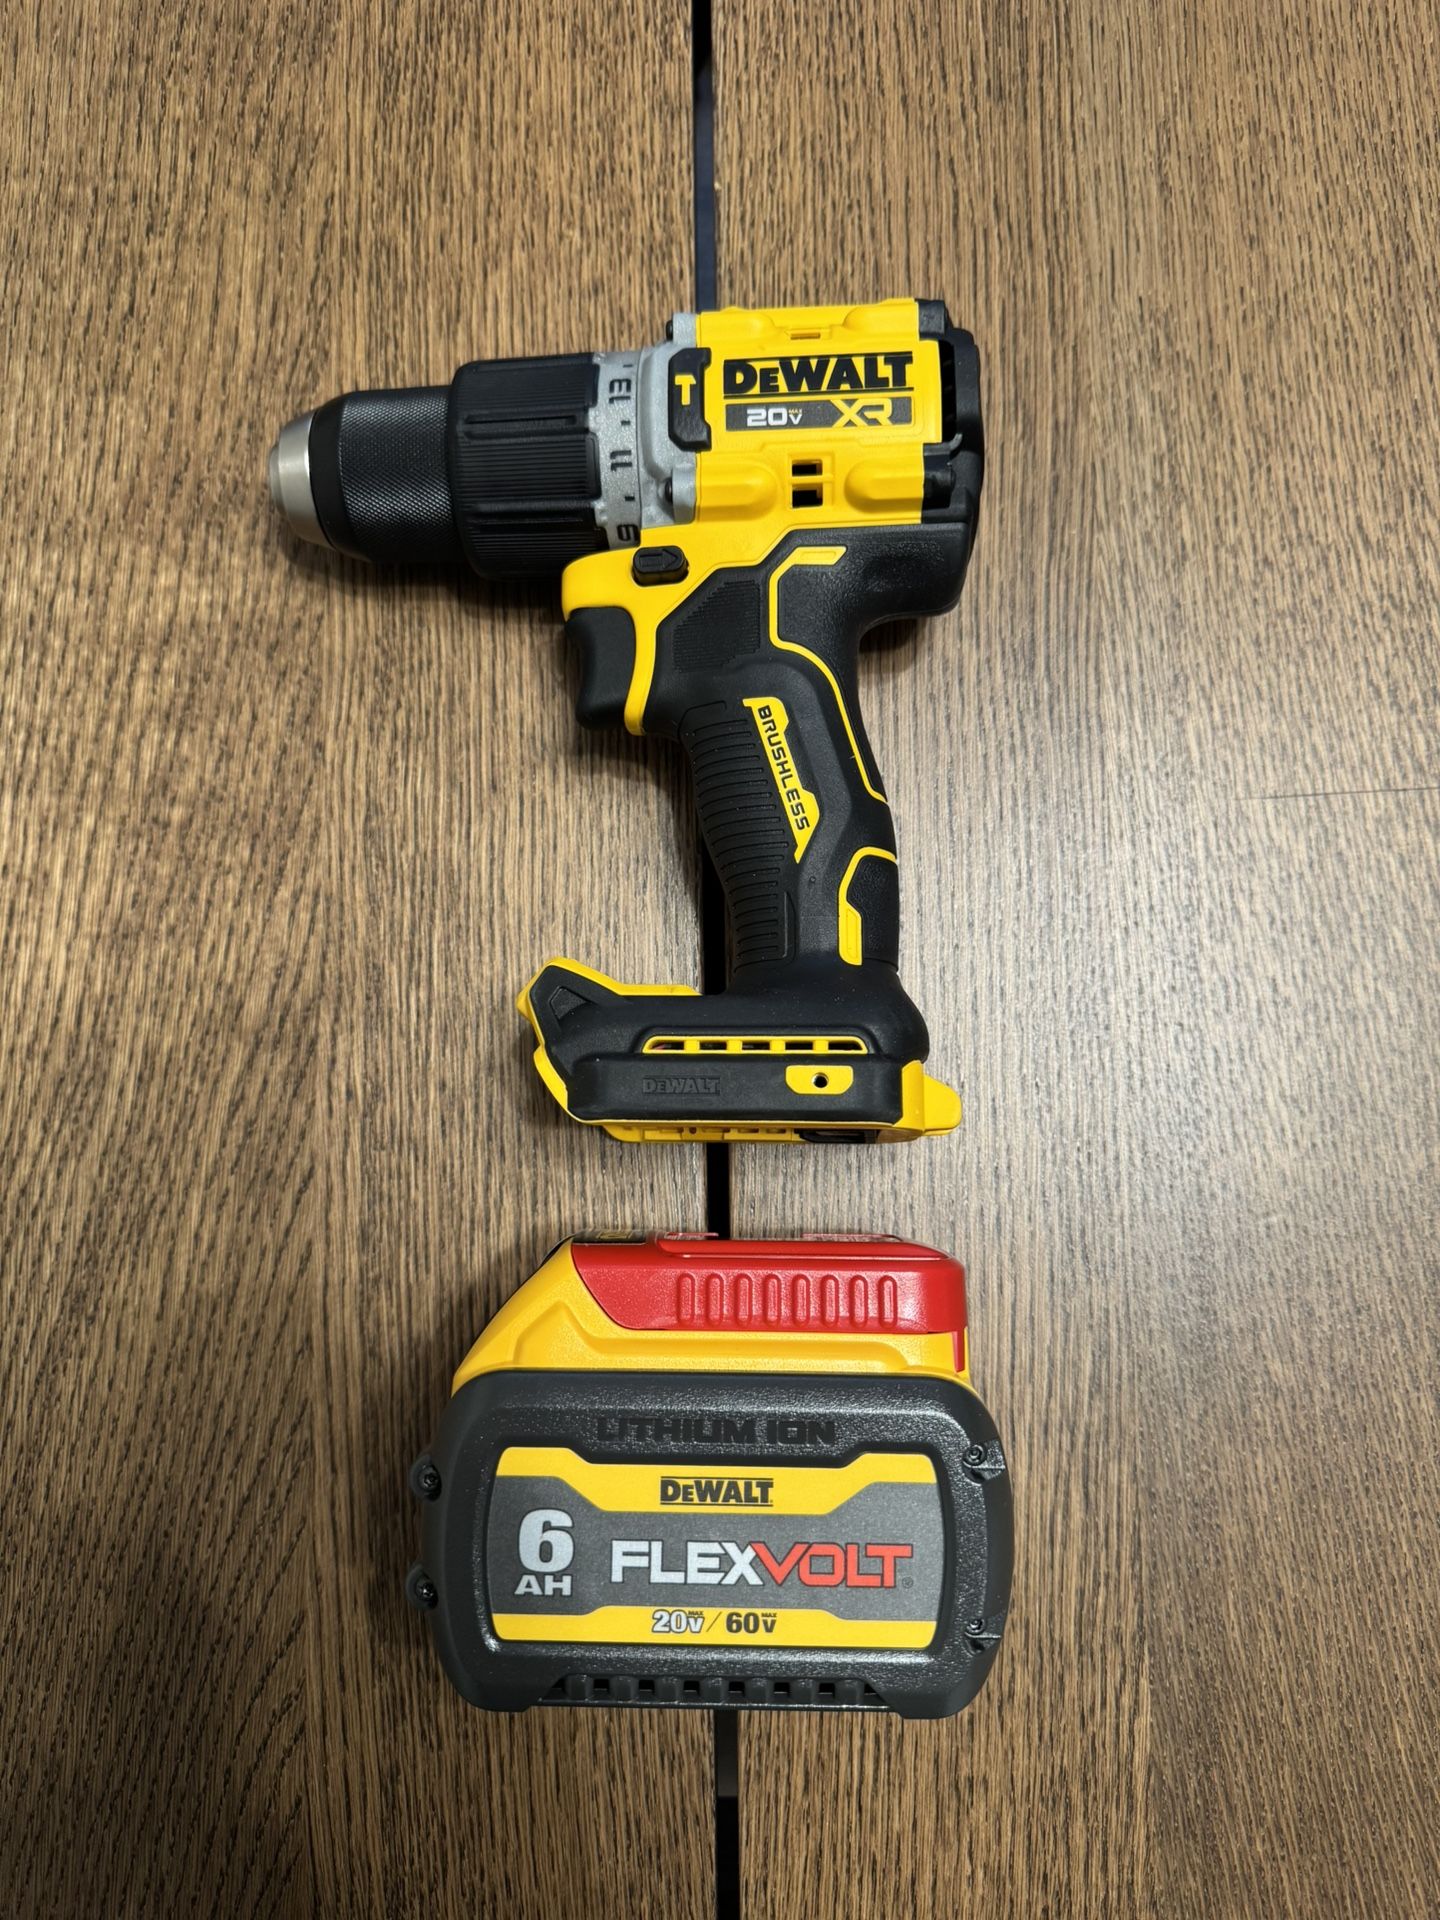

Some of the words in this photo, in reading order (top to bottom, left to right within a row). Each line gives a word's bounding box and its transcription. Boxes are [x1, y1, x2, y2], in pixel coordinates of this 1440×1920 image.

[608, 378, 632, 404] 13
[830, 397, 893, 428] XR
[609, 450, 633, 472] 11
[757, 704, 811, 831] BRUSHLESS
[598, 1417, 757, 1444] LITHIUM
[766, 1418, 836, 1446] ION
[518, 1509, 575, 1573] 6
[610, 1539, 913, 1588] FLEXVOLT
[514, 1574, 573, 1597] AH
